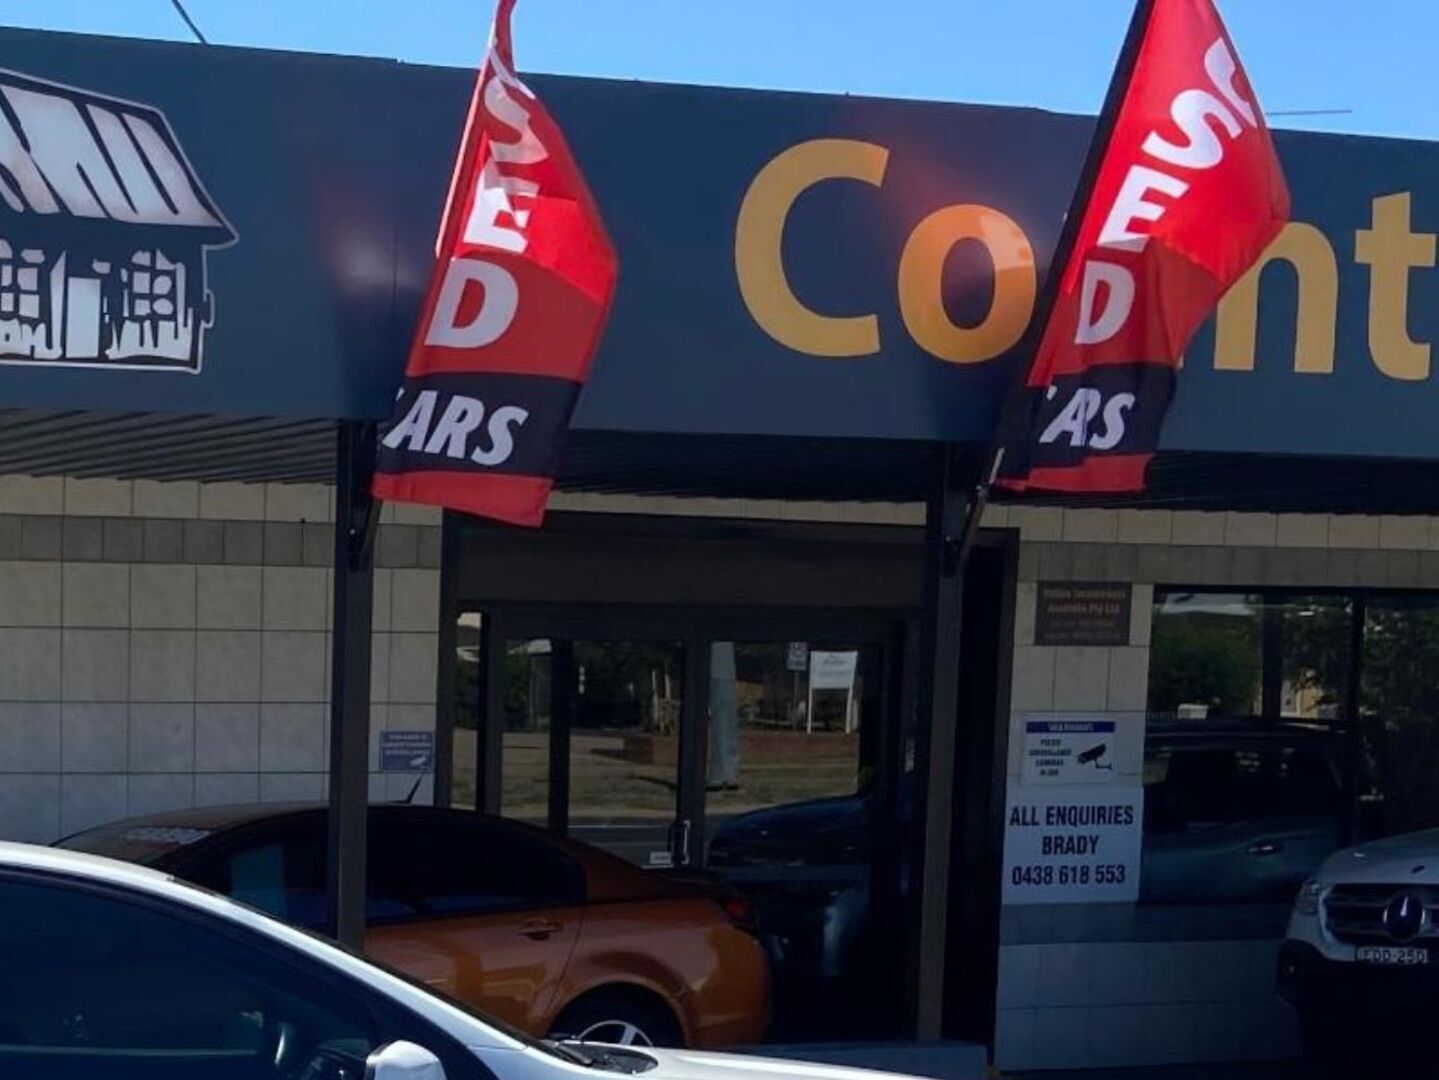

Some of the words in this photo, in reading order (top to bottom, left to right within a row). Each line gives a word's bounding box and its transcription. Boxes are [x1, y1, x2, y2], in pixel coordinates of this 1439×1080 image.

[735, 138, 1438, 381] Cont
[382, 387, 529, 467] ARS
[1009, 806, 1040, 826] ALL
[1046, 805, 1134, 828] ENQUIRIES
[1042, 834, 1100, 856] BRADY
[1012, 865, 1054, 886] 0438
[1058, 865, 1090, 885] 618
[1095, 863, 1127, 884] 553
